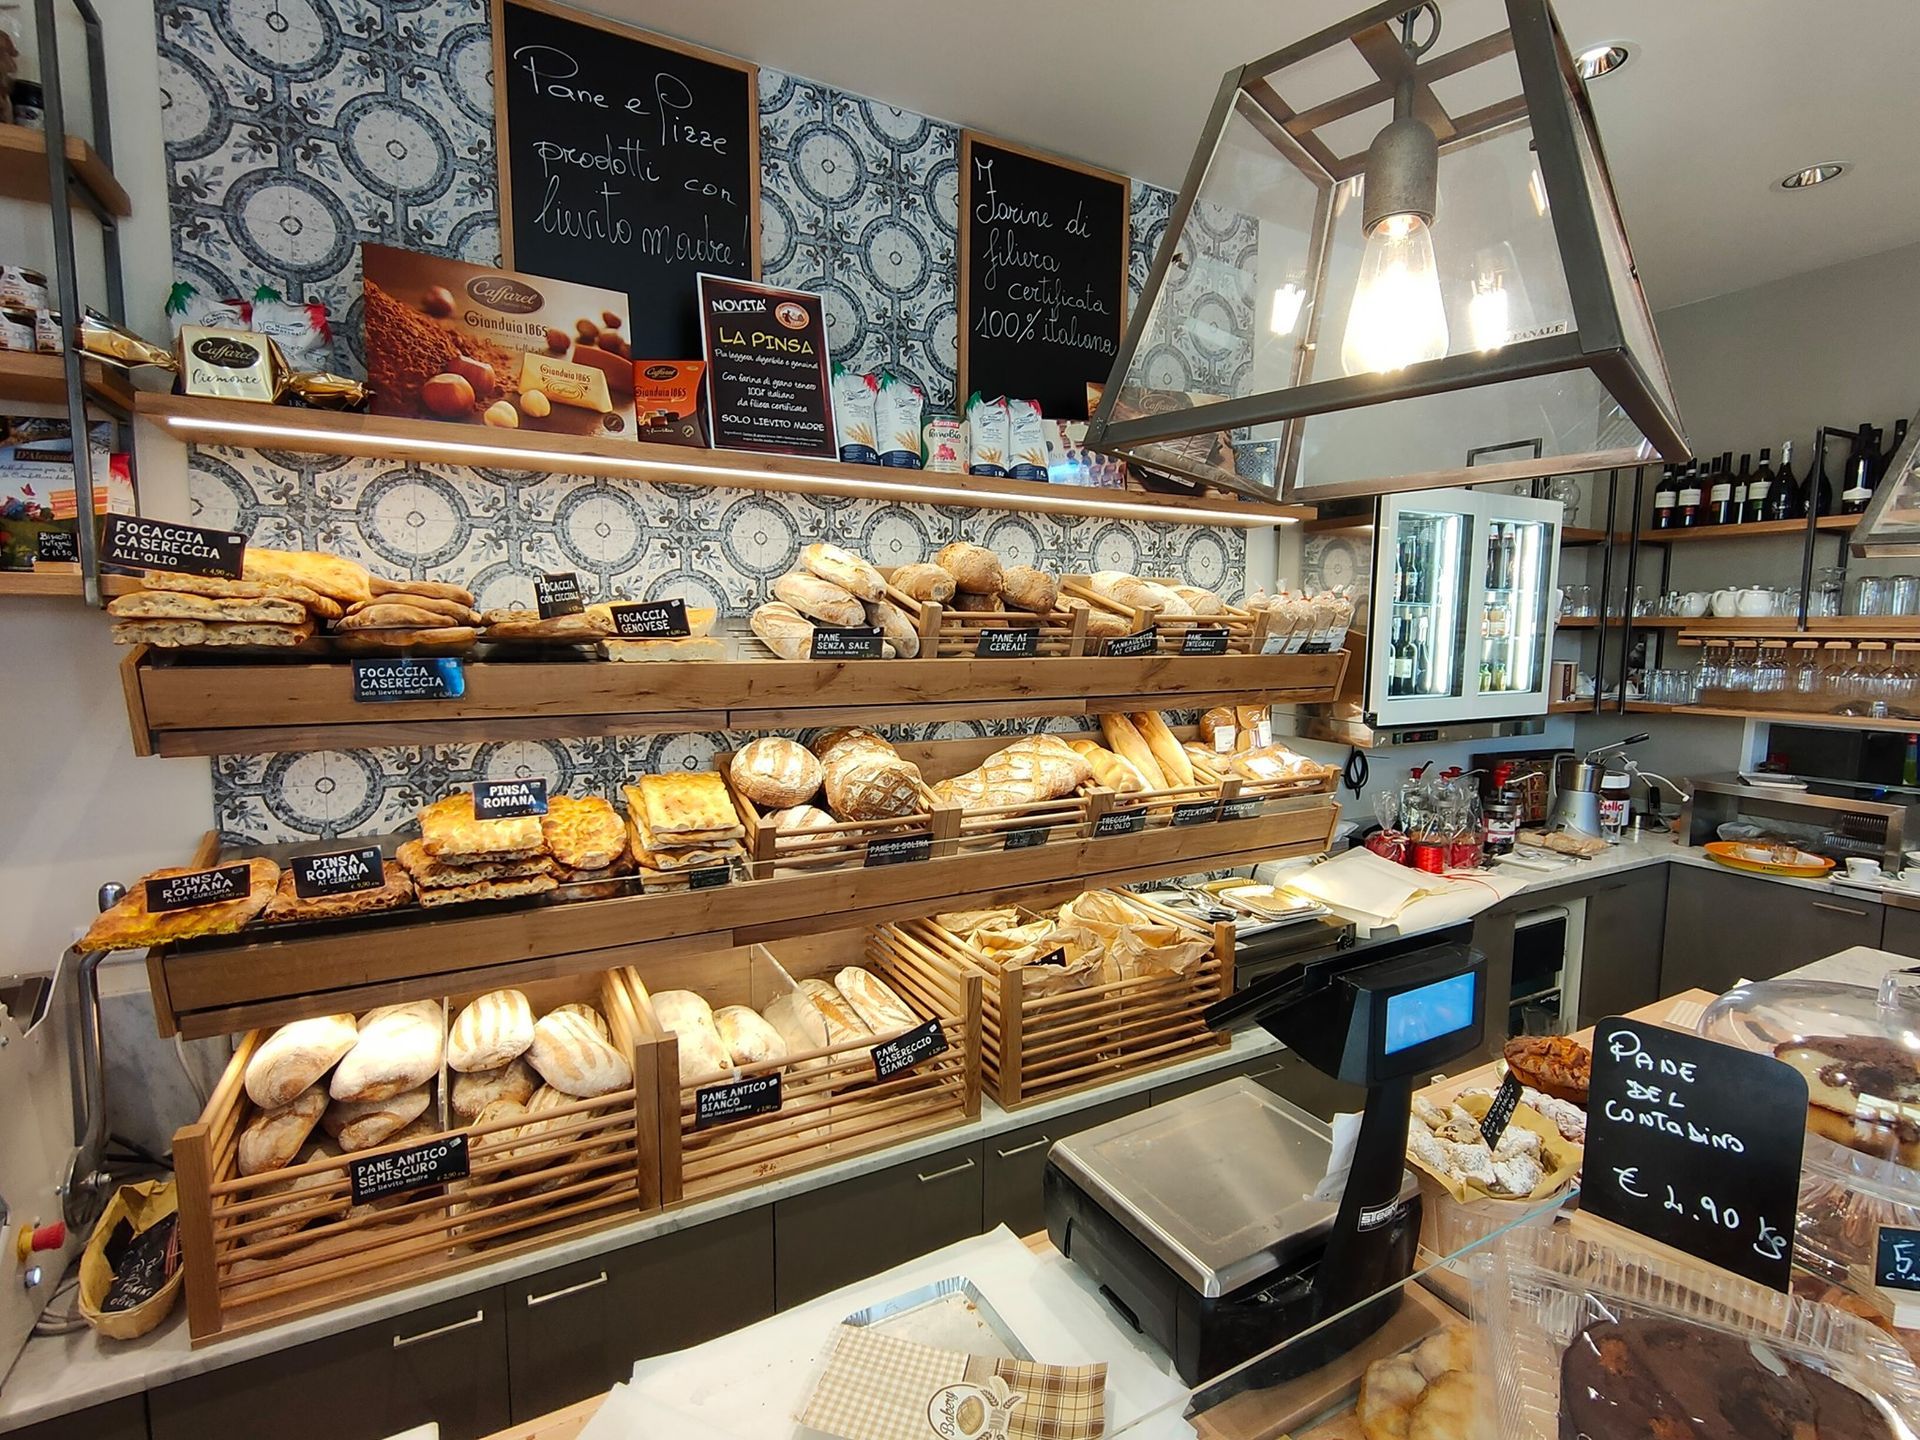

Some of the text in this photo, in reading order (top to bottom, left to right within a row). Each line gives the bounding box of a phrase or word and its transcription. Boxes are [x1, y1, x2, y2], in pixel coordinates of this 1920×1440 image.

[514, 45, 728, 155] Pane e Pizze
[533, 134, 737, 207] prodotti con
[975, 157, 1092, 239] Farine di
[533, 174, 633, 245] lievito
[983, 227, 1061, 291] filiera
[472, 280, 539, 309] Caffarel
[1007, 276, 1111, 321] certificata
[464, 310, 549, 339] Gianduia 1865
[975, 306, 1042, 344] 100%
[197, 340, 254, 360] Caffarel
[719, 326, 815, 356] LA PINSA
[192, 367, 263, 386] Piemonte
[721, 413, 826, 432] SOLO LIEVITO MADRE
[115, 519, 204, 546] FOCACCIA
[113, 533, 221, 560] CASERECCIA
[112, 548, 178, 567] ALL'OLIO
[539, 579, 576, 594] FOCACCIA
[540, 594, 554, 605] CON
[617, 608, 670, 624] FOCACCIA
[620, 619, 671, 634] GENOVESE
[816, 641, 870, 650] SENZA SALE
[818, 633, 841, 642] PANE
[991, 633, 1028, 643] PANE AI
[1184, 640, 1217, 648] INTEGRALE
[1187, 632, 1203, 641] PANE
[989, 642, 1027, 652] CEREALI
[1113, 639, 1152, 657] AI CEREALI
[358, 666, 429, 679] FOCACCIA
[360, 676, 445, 690] CASERECCIA
[361, 689, 377, 697] solo
[378, 687, 403, 697] lievito
[489, 783, 531, 798] PINSA
[482, 794, 537, 810] ROMANA
[1599, 801, 1624, 812] tella
[1099, 822, 1132, 832] ALL'OLIO
[869, 844, 891, 854] PANE
[891, 842, 901, 851] DI
[312, 853, 361, 871] PINSA
[171, 871, 224, 889] PINSA
[305, 862, 370, 882] ROMANA
[317, 874, 362, 887] AI CEREALI
[162, 878, 234, 899] ROMANA
[166, 887, 231, 904] ALLA CURCUMA
[876, 1042, 900, 1060] PANE
[879, 1035, 933, 1067] CASERECCIO
[1607, 1030, 1698, 1083] PANE
[881, 1054, 914, 1076] BIANCO
[701, 1080, 768, 1104] PANE ANTICO
[1626, 1078, 1686, 1109] DEL
[701, 1096, 741, 1113] BIANCO
[357, 1145, 448, 1178] PANE ANTICO
[358, 1159, 438, 1189] SEMISCURO
[1612, 1166, 1649, 1198] €
[359, 1173, 429, 1196] solo lievito madre
[939, 1389, 960, 1437] Bakery
